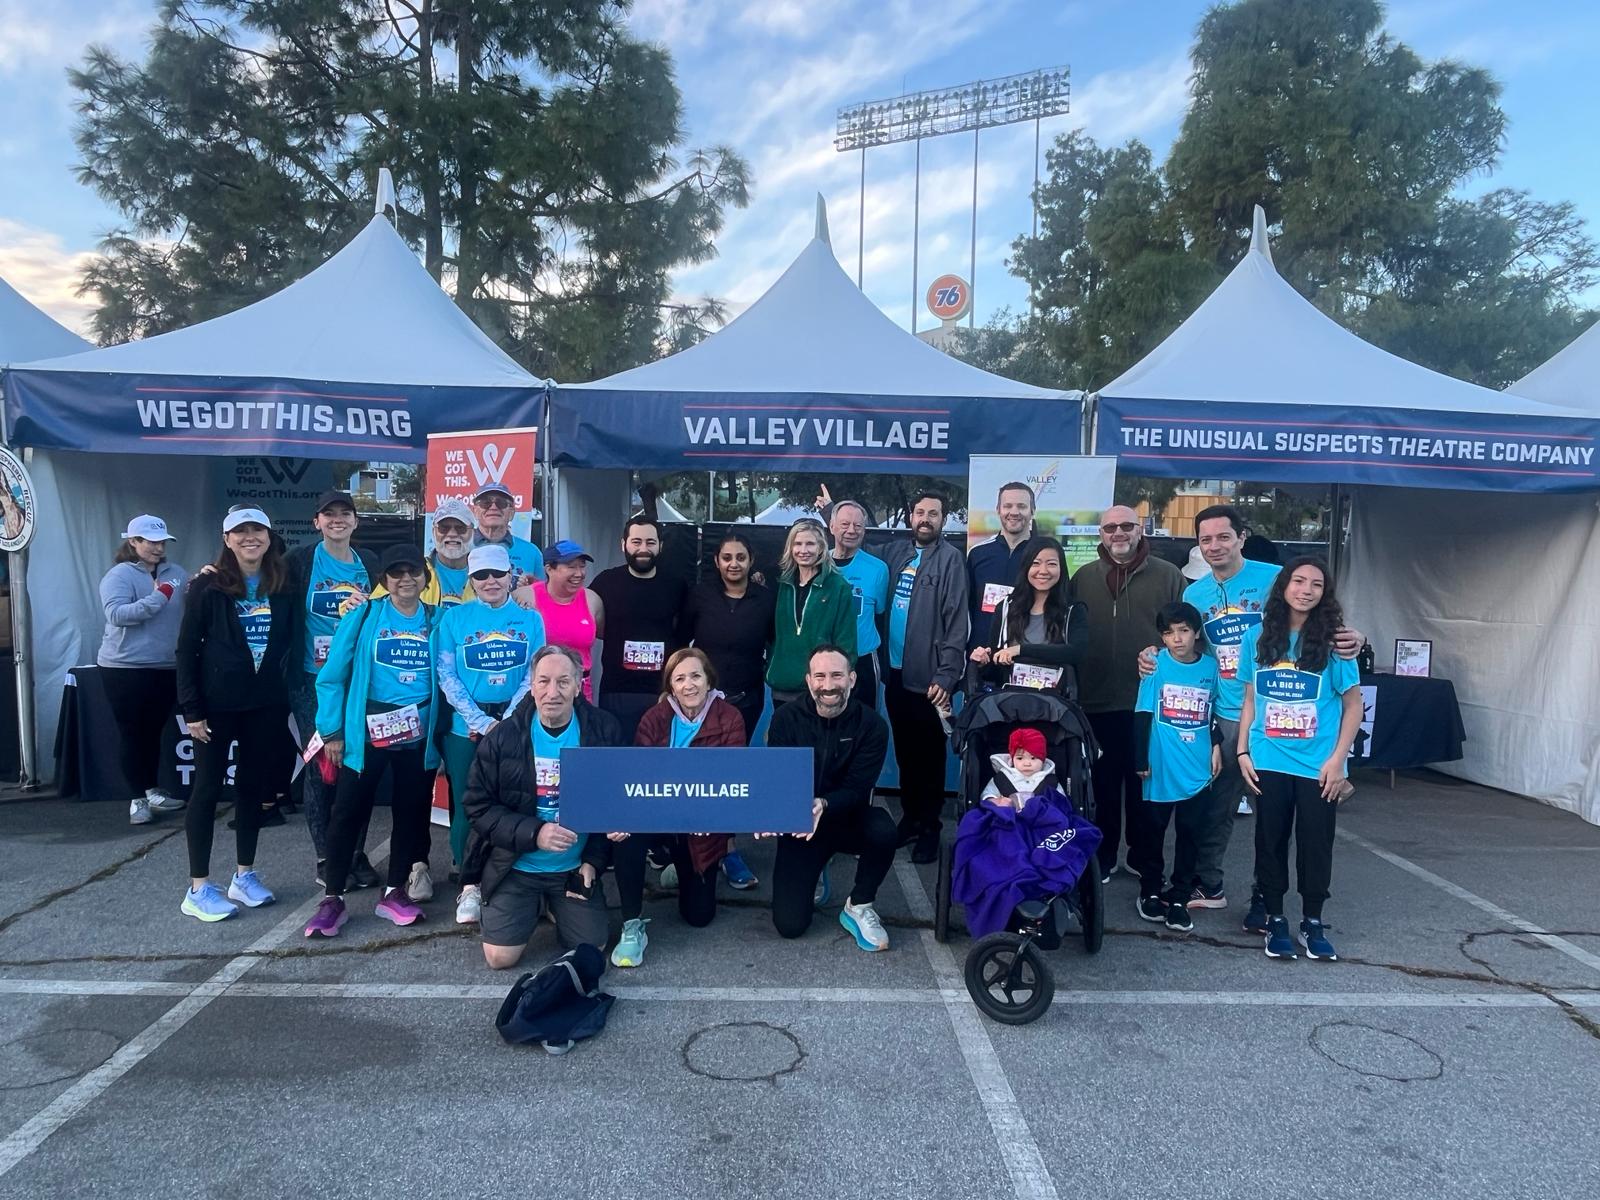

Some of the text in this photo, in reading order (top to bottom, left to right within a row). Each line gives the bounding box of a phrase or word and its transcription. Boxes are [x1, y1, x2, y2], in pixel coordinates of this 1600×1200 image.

[935, 285, 961, 308] 76
[136, 399, 411, 437] WEGOTTHIS.ORG
[684, 417, 950, 449] VALLEY VILLAGE
[1120, 427, 1594, 465] THE UNUSUAL SUSPECTS THEATRE COMPANY
[445, 450, 463, 461] WE
[236, 467, 260, 475] GOT
[445, 463, 466, 475] GOT
[444, 476, 470, 487] THIS.
[1026, 475, 1057, 484] VALLEY
[23, 489, 32, 525] RESCUE
[245, 625, 256, 633] LA
[1216, 628, 1226, 636] LA
[1227, 626, 1240, 634] BIG
[403, 649, 416, 657] BIG
[419, 650, 429, 658] 5K
[478, 652, 489, 660] LA
[490, 651, 504, 659] BIG
[1266, 680, 1306, 690] LA BIG 5K
[624, 783, 749, 798] VALLEY VILLAGE
